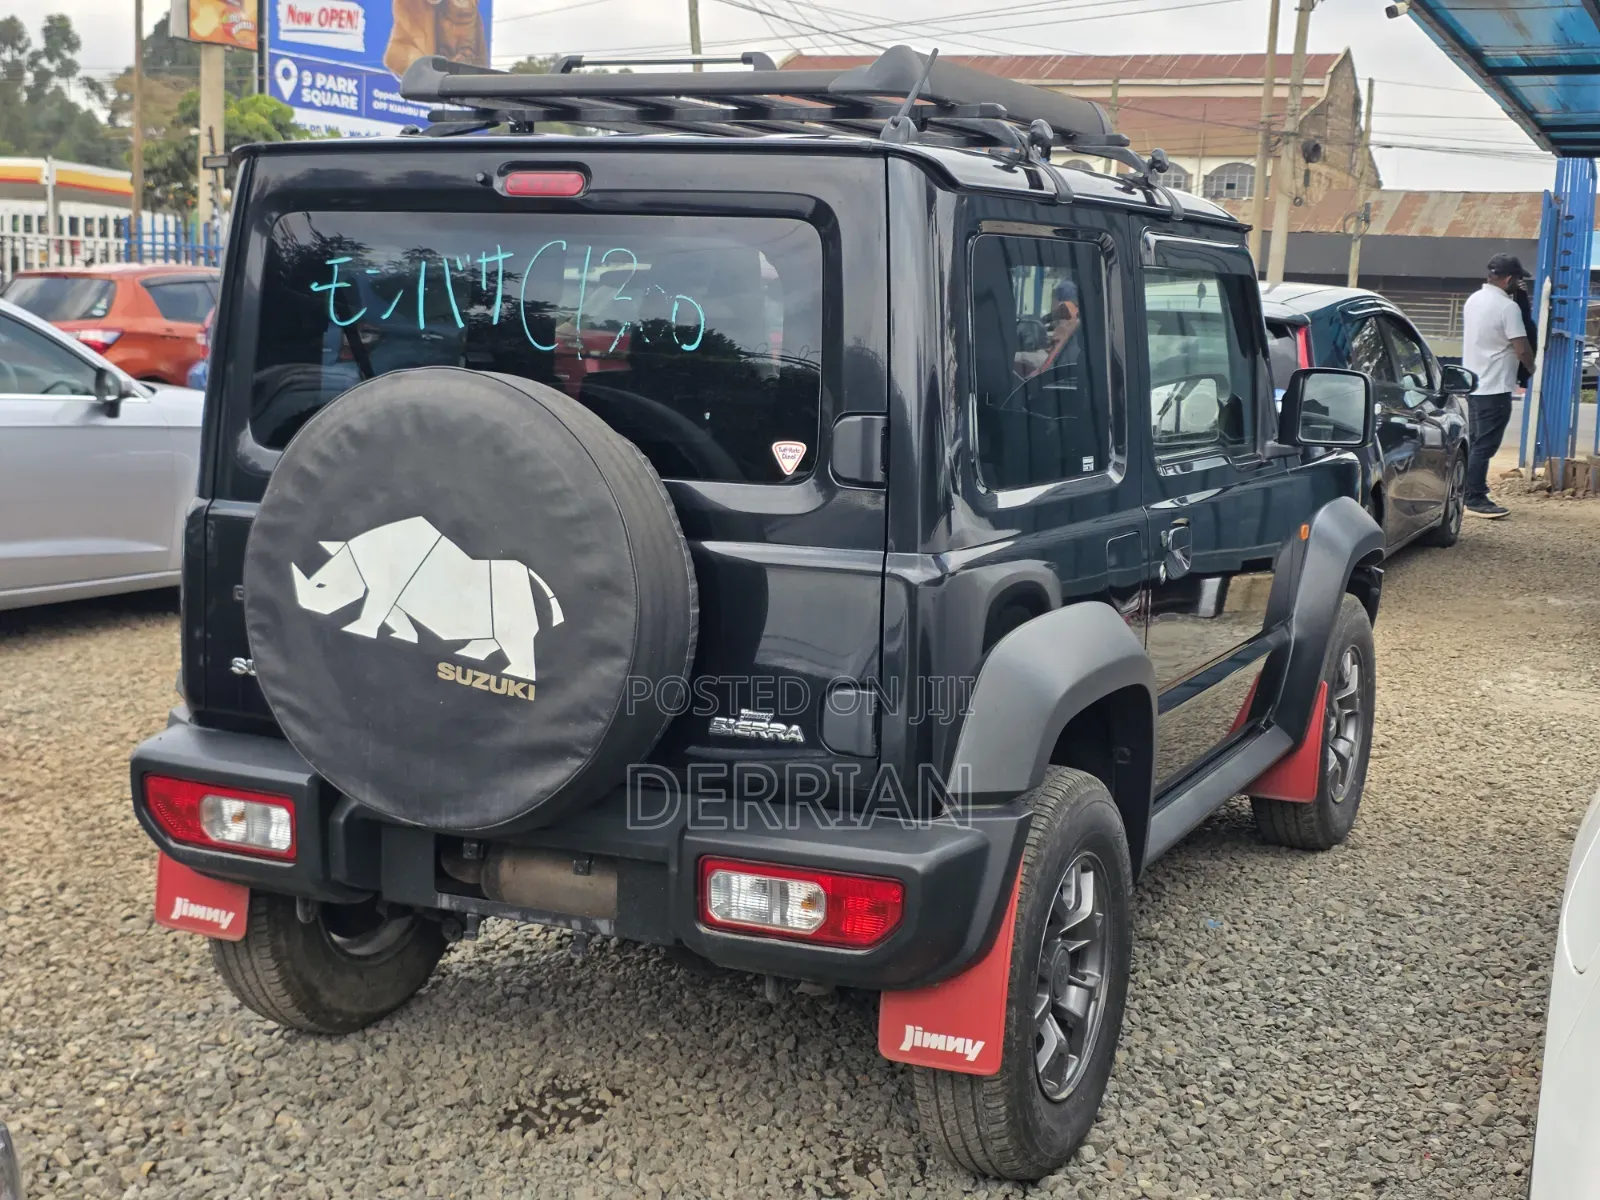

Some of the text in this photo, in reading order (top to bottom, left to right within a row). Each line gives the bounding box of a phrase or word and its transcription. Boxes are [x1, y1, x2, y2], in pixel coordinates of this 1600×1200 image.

[286, 4, 359, 30] Now OPEN!
[301, 70, 359, 96] 9 PARK
[301, 87, 359, 110] SQUARE
[310, 244, 514, 331] モンバサ
[437, 661, 536, 701] SUZUKI
[170, 896, 236, 930] Jimny
[899, 1024, 985, 1062] Jimny
